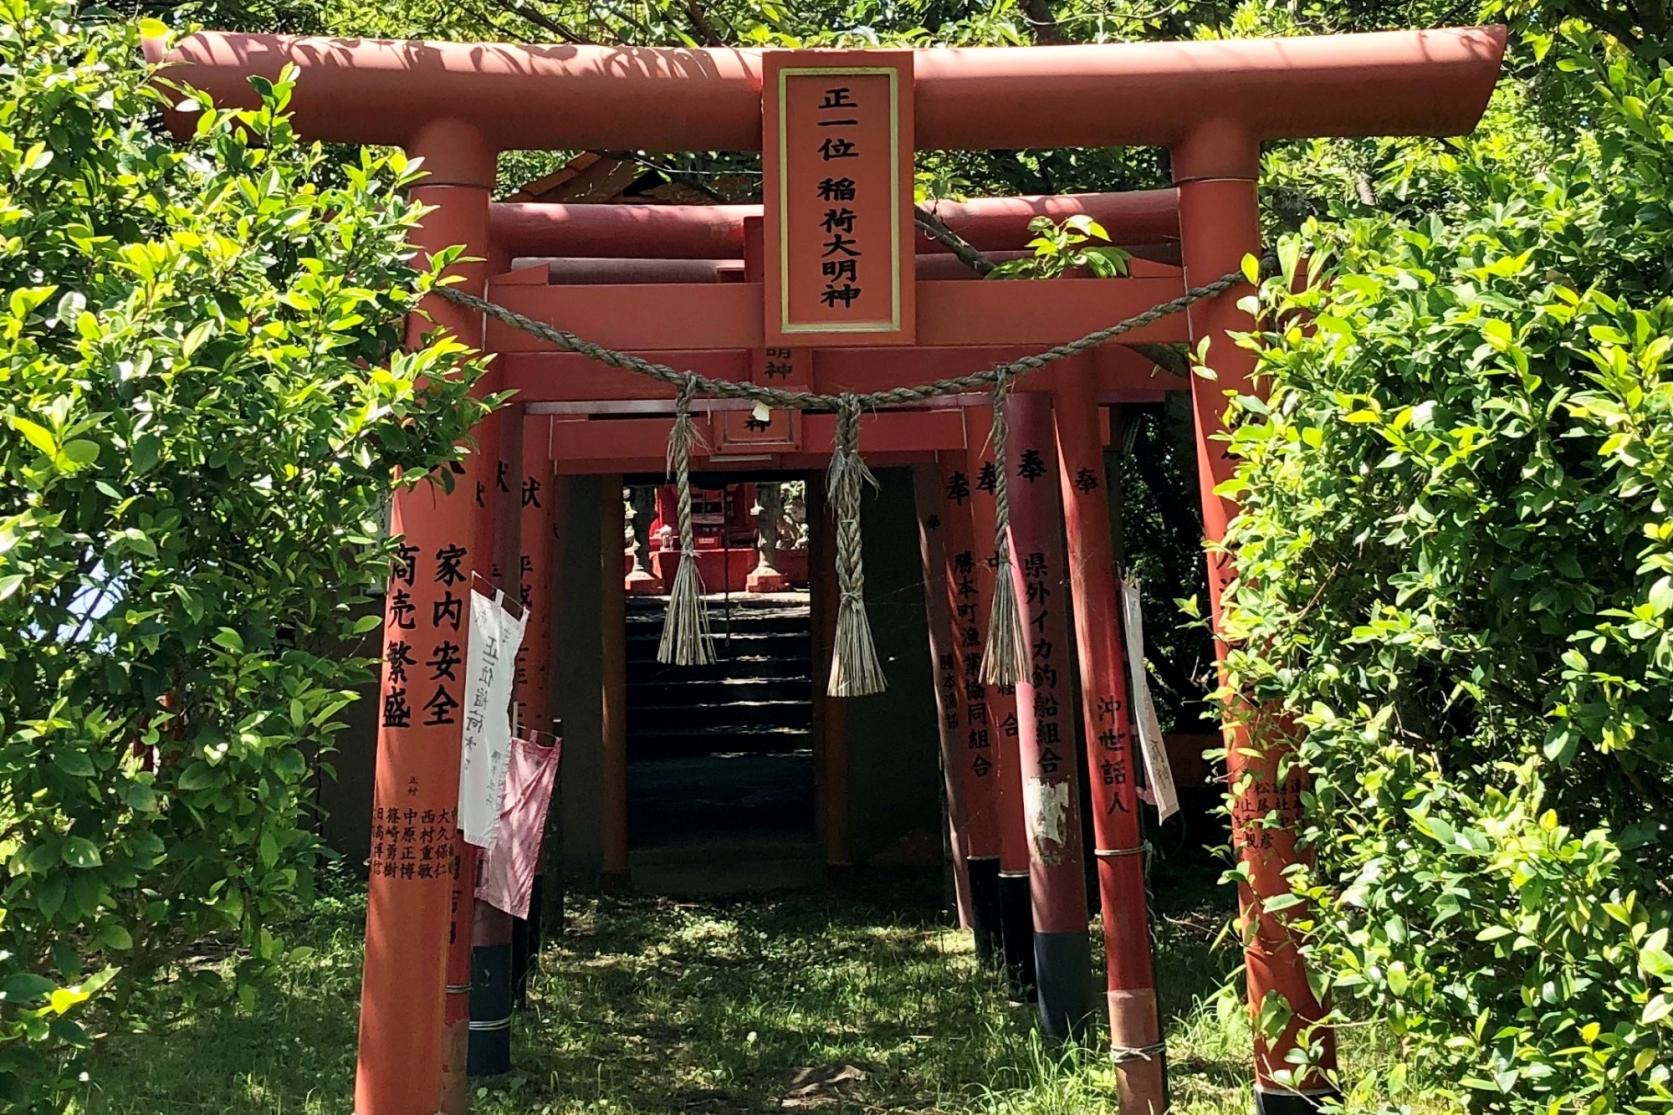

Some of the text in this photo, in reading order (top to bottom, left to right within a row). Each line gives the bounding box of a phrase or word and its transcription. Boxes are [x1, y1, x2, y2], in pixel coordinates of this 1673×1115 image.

[1018, 449, 1047, 482] 奉
[1075, 467, 1099, 495] 奉
[382, 543, 420, 728] 商売繁盛
[422, 544, 467, 726] 家内安全
[1024, 552, 1063, 775] 県外イカ釣船組合
[1097, 696, 1130, 815] 沖世話人
